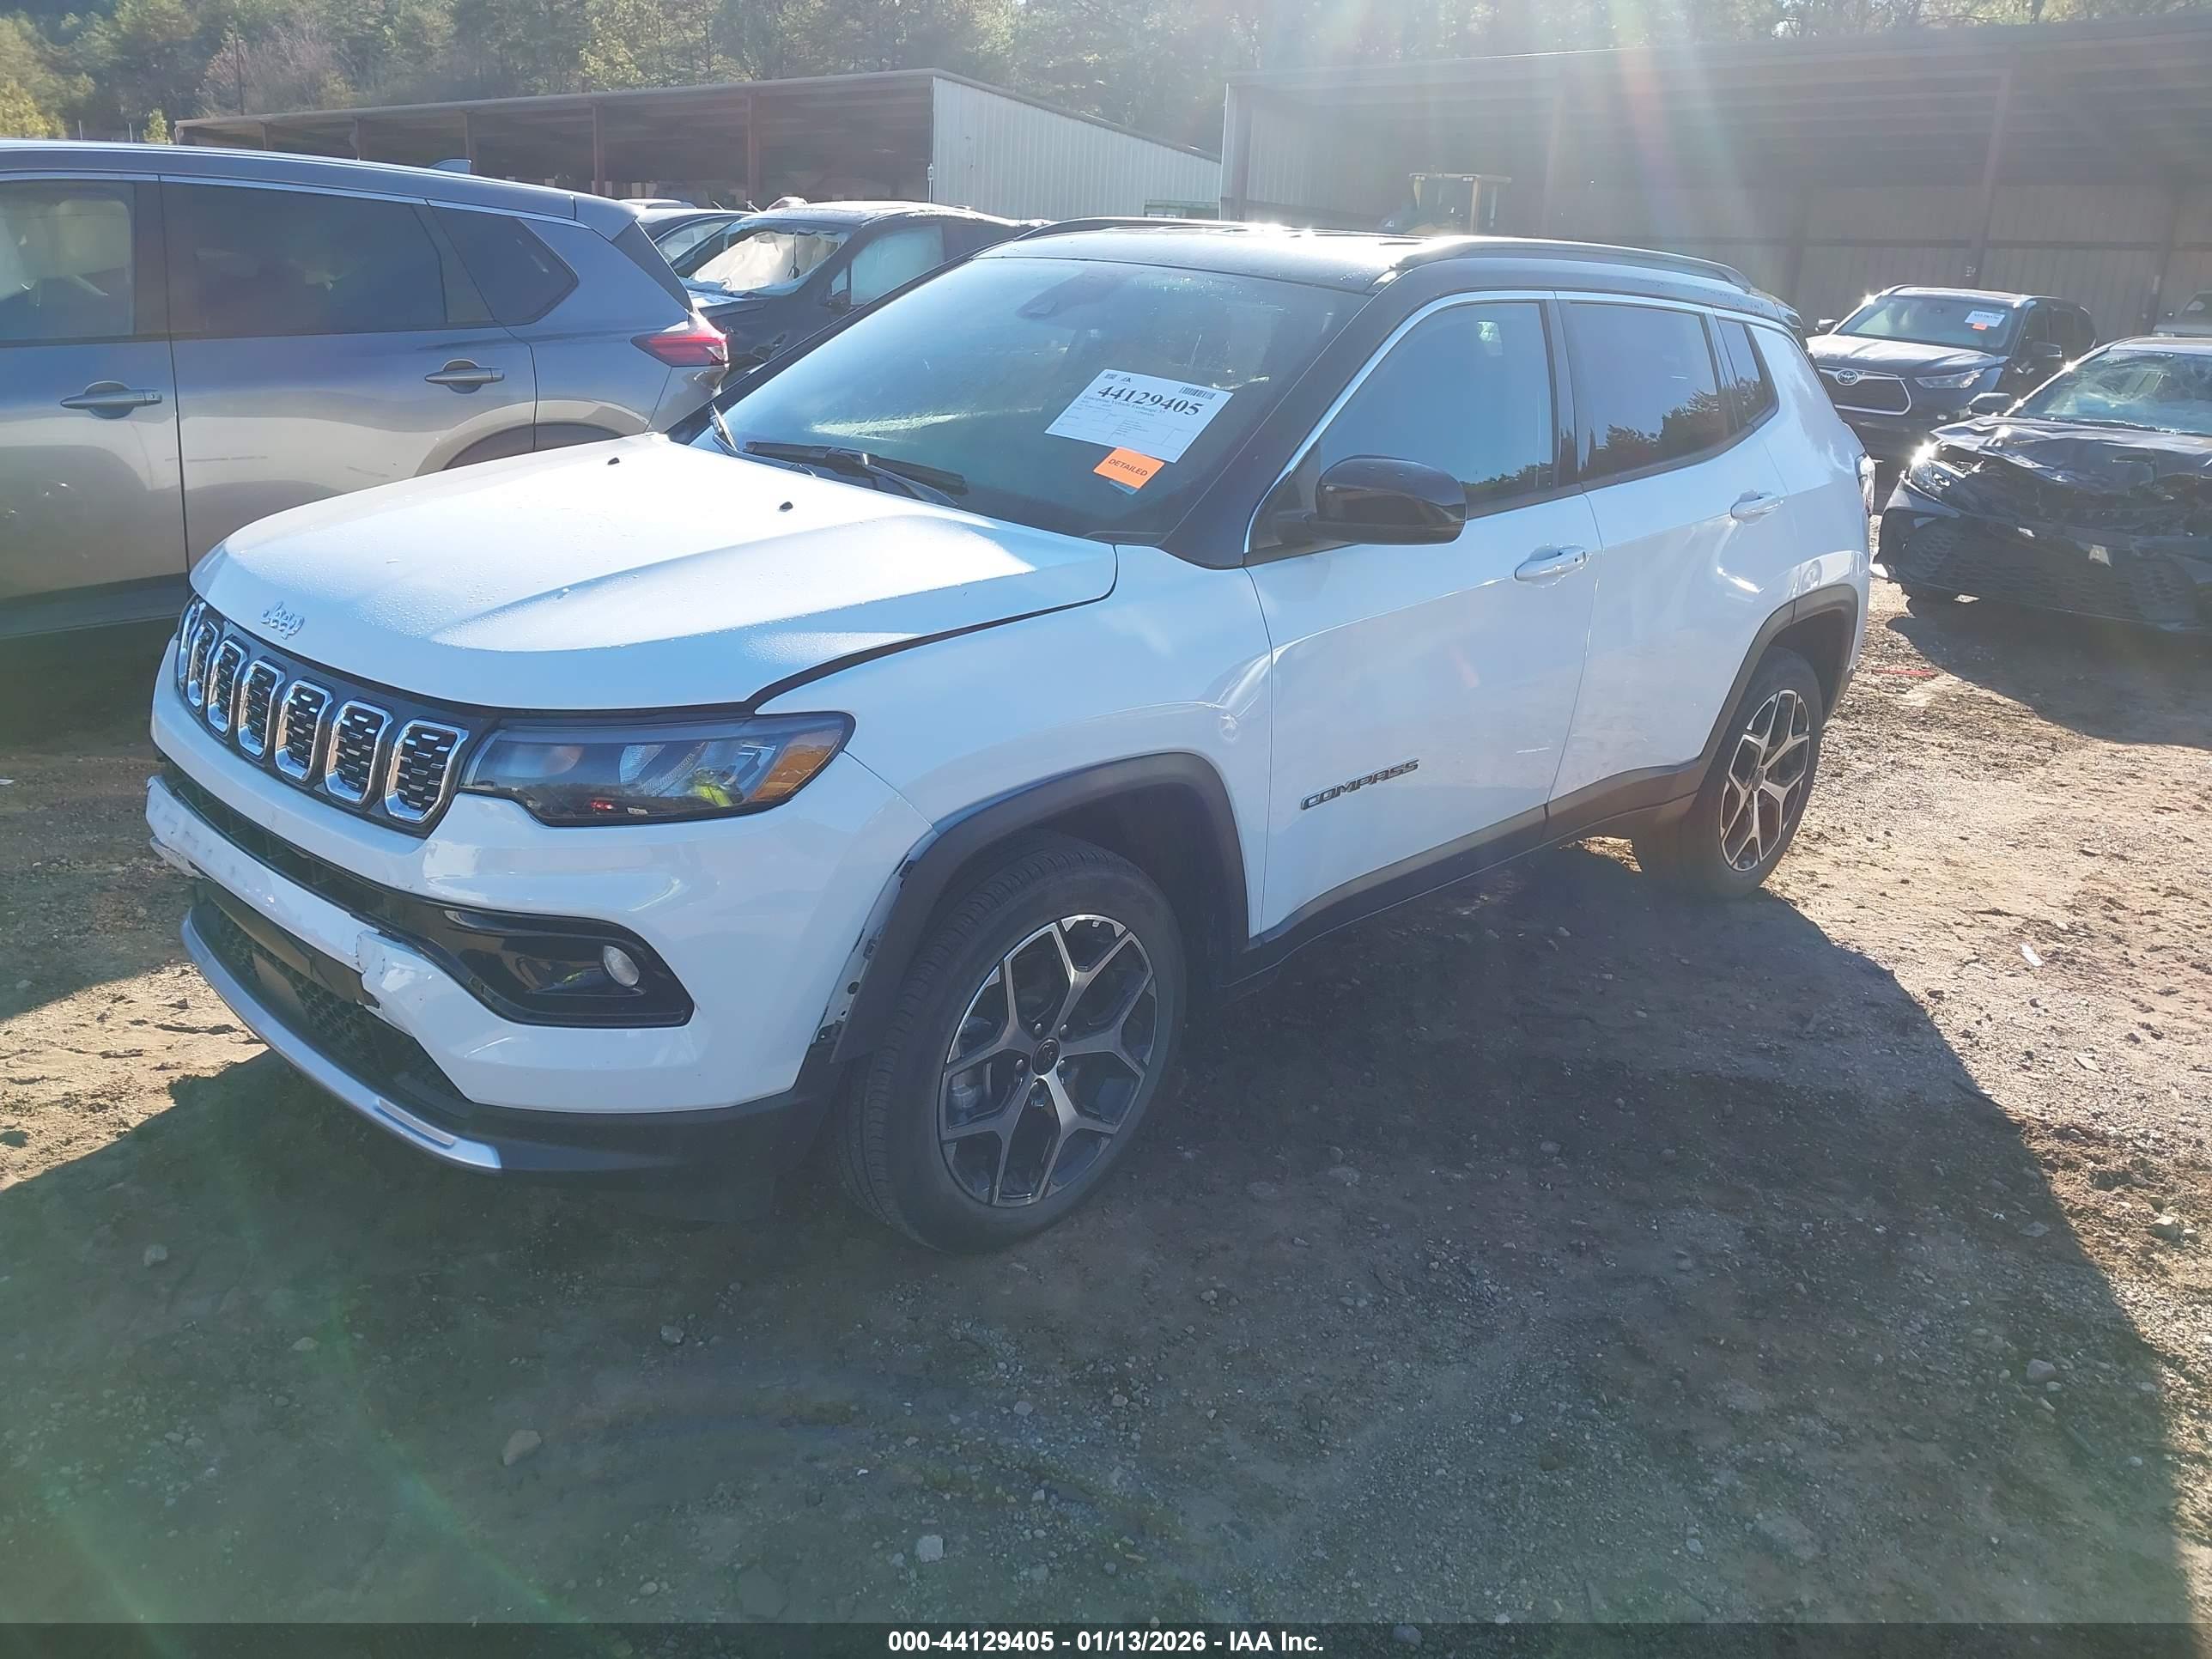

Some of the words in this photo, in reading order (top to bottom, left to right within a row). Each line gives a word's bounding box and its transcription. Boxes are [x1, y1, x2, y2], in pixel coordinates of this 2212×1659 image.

[1097, 386, 1205, 416] 44129405
[1108, 459, 1148, 477] DETAILED
[261, 601, 305, 640] Jeep
[1300, 758, 1419, 810] COMPASS
